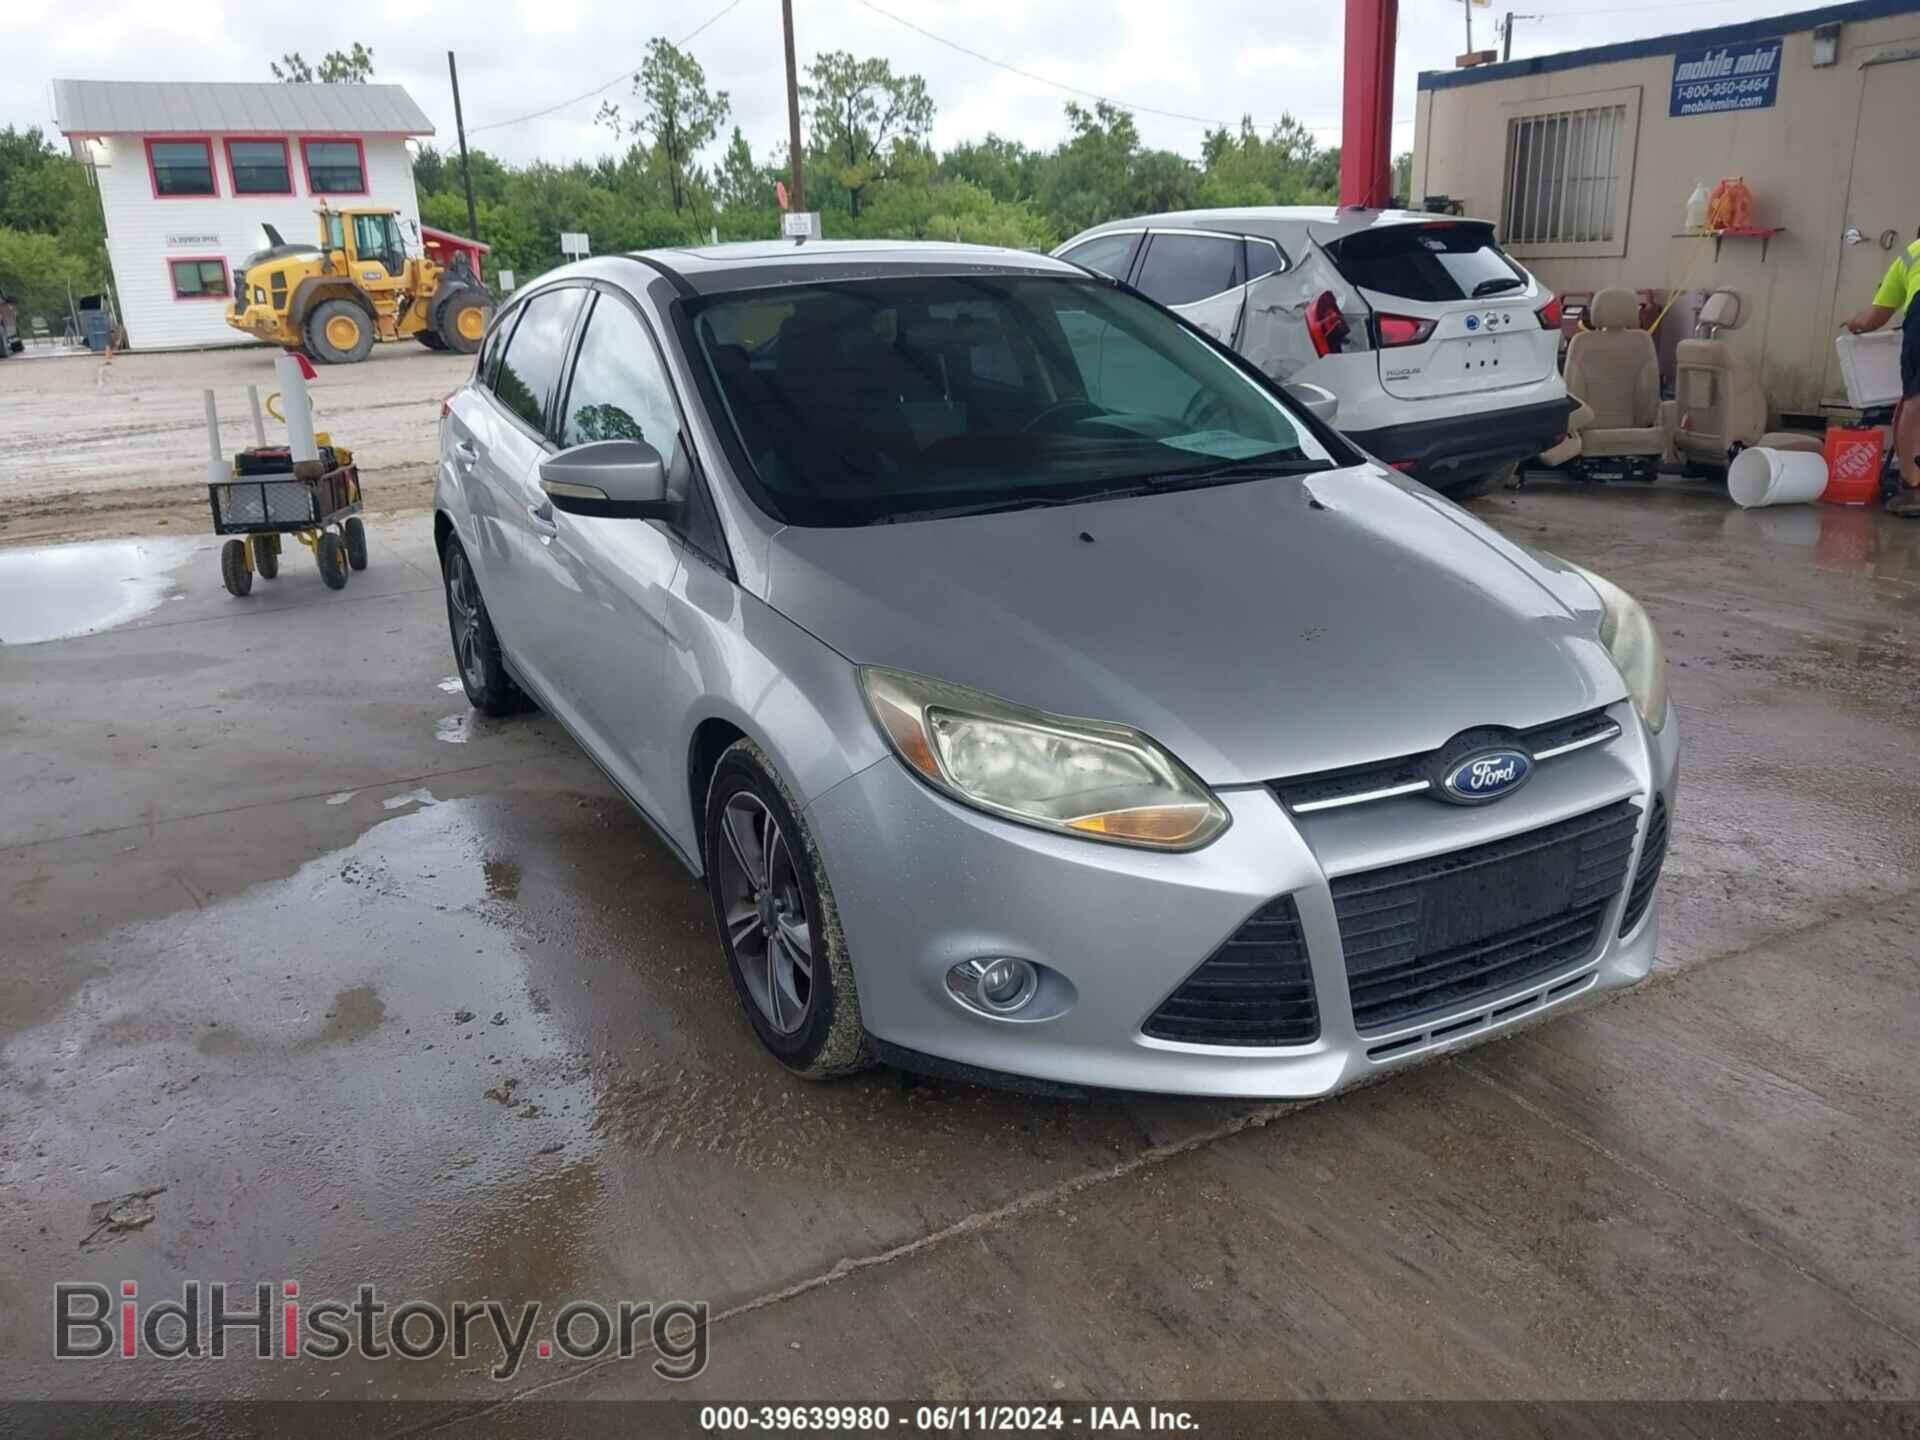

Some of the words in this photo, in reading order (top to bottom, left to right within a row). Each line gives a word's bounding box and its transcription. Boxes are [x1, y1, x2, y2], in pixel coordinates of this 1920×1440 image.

[1675, 50, 1734, 82] mobile
[1734, 46, 1778, 74] mini
[1677, 77, 1770, 100] 1-800-950-6464
[1681, 96, 1763, 114] mobilemini.com
[1471, 758, 1516, 789] Ford
